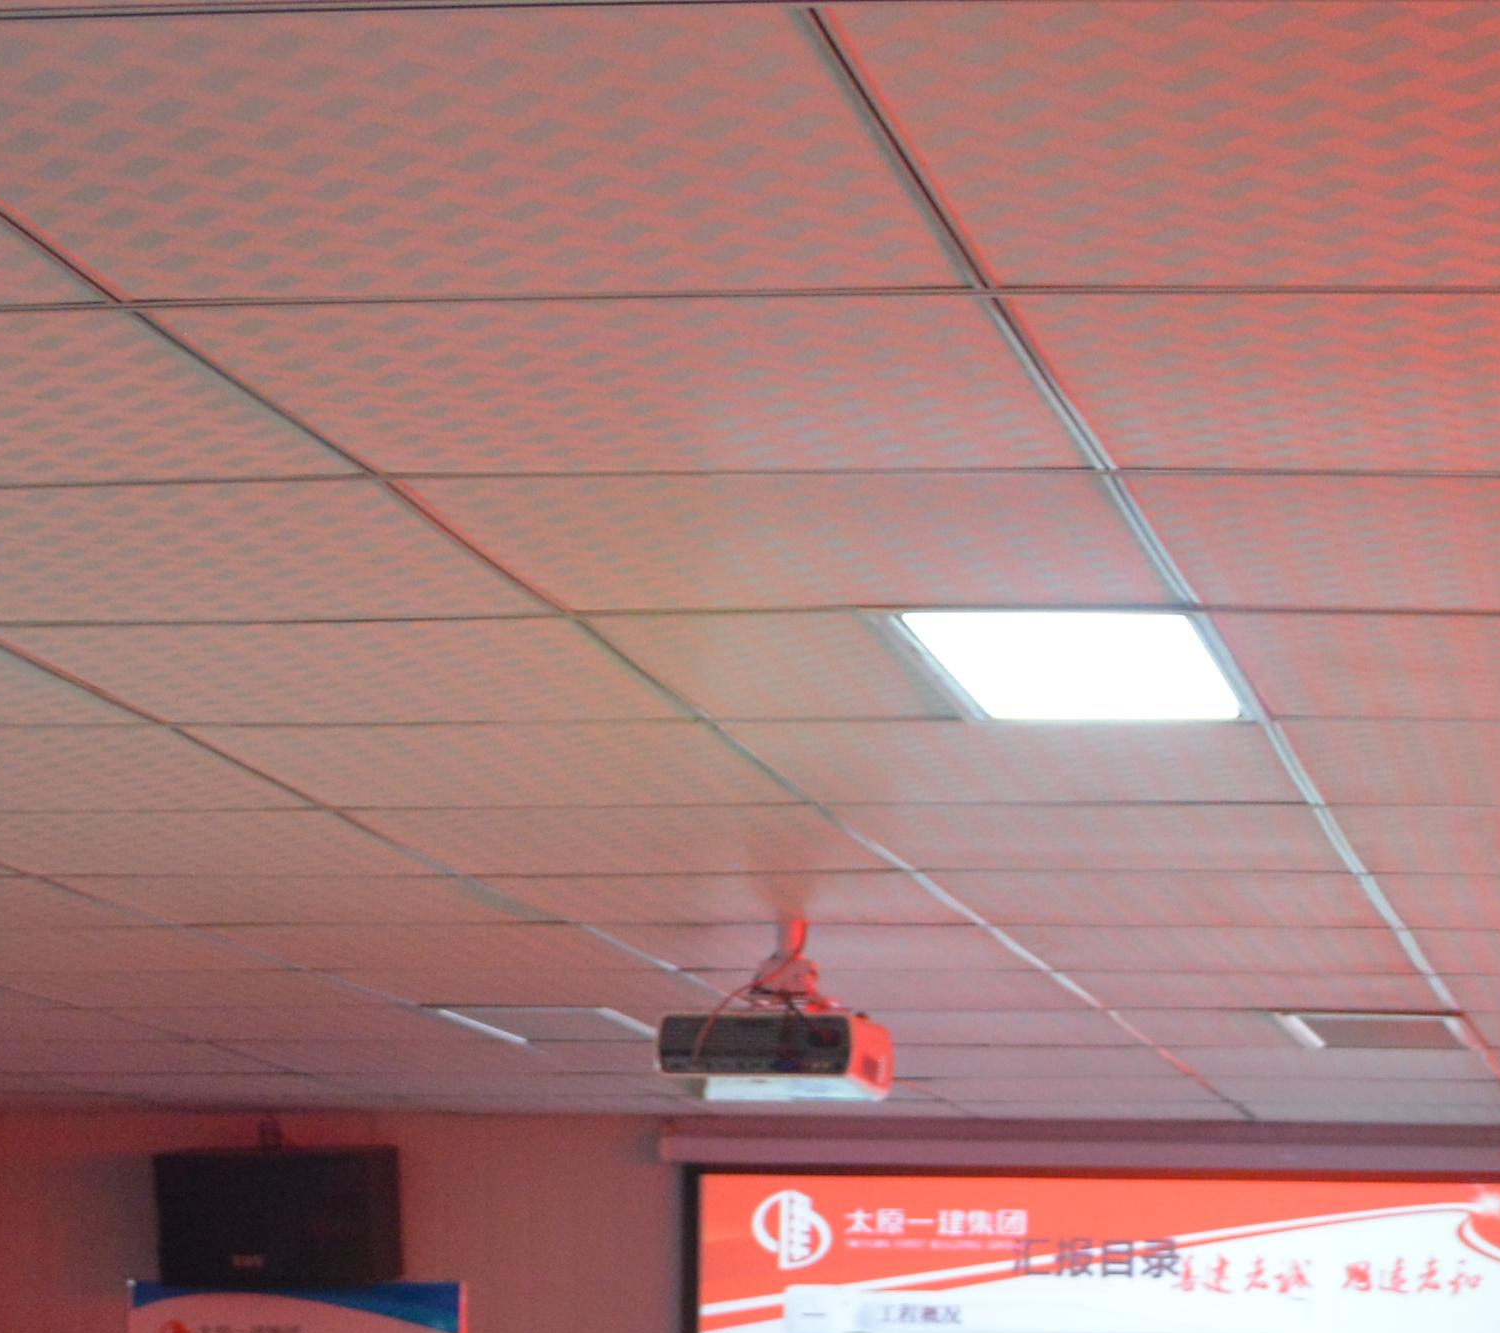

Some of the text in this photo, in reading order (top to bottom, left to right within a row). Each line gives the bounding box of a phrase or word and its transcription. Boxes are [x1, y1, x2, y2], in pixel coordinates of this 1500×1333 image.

[845, 1208, 1028, 1236] 太原一建集团
[1013, 1237, 1181, 1279] 汇报目录
[881, 1304, 962, 1325] 工程概况
